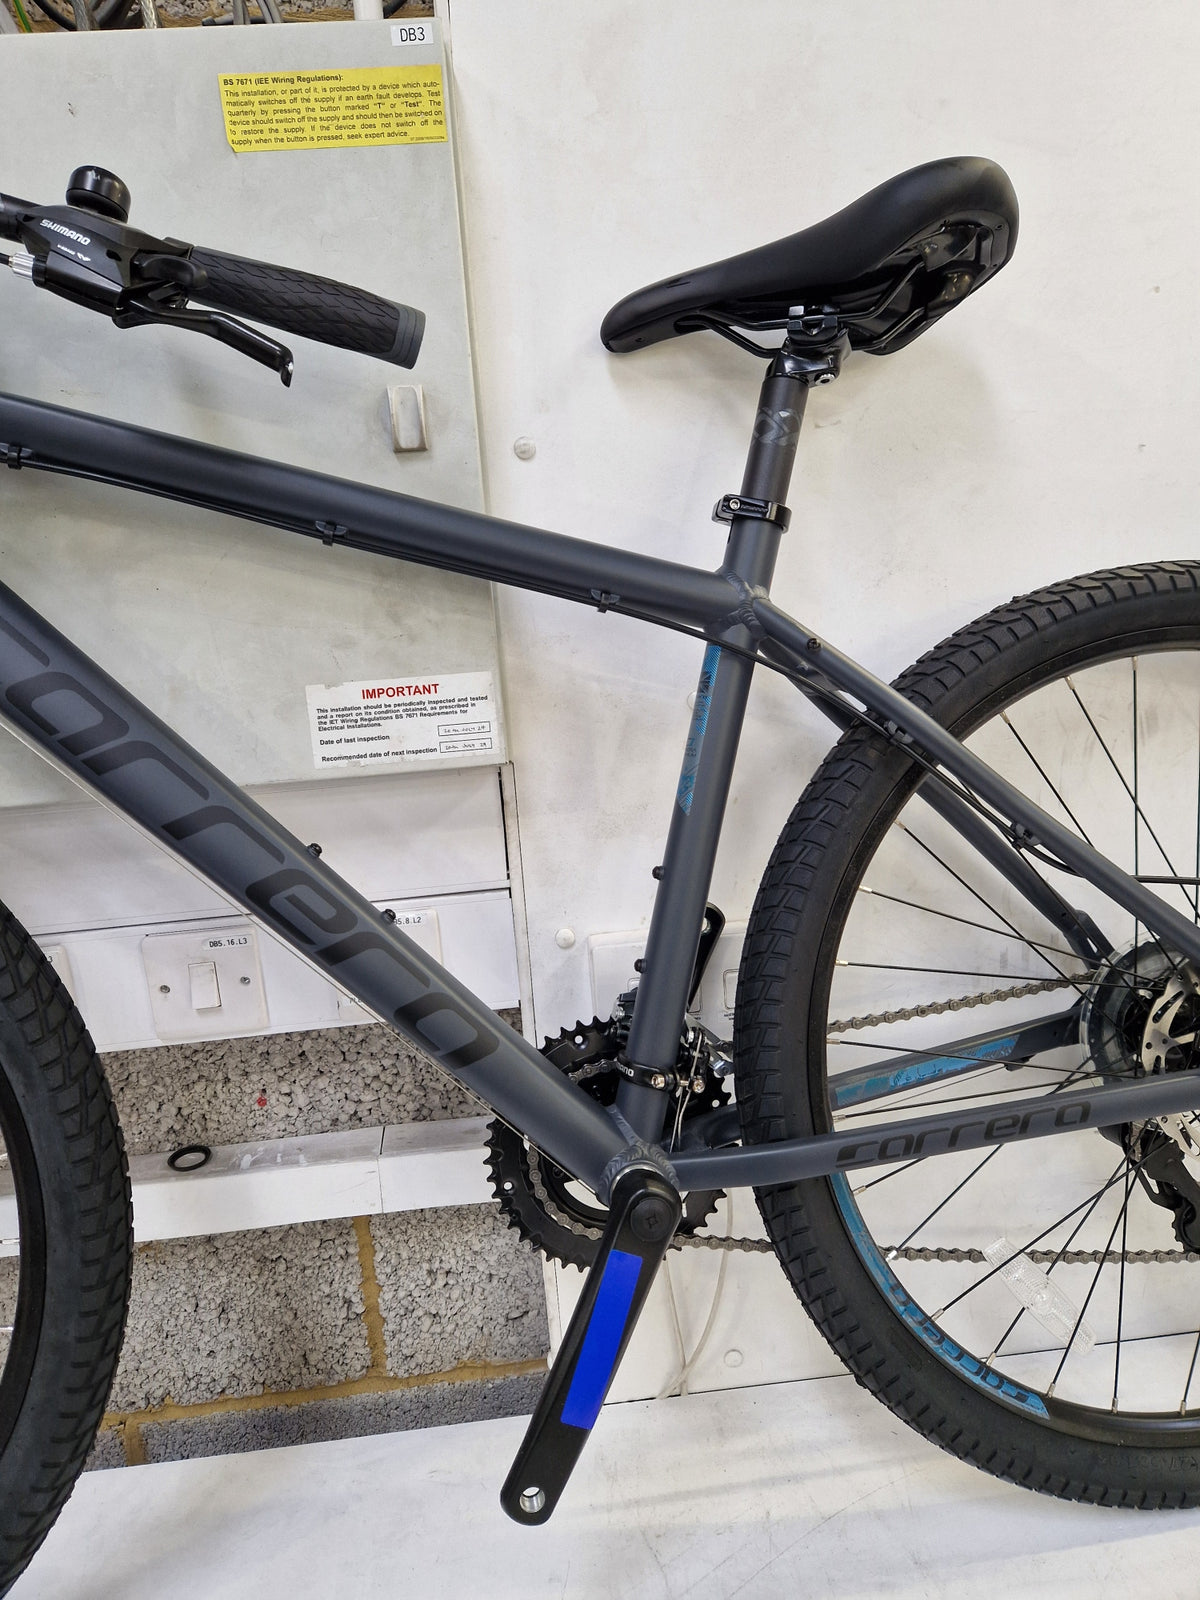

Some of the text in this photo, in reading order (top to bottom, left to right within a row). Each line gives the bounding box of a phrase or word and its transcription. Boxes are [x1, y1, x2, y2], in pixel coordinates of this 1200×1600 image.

[400, 26, 425, 42] DB3
[255, 78, 269, 86] (IEE
[271, 76, 294, 85] Wiring
[297, 74, 343, 84] Regulations):
[242, 88, 278, 96] installation,
[40, 219, 91, 246] SHIMANO
[362, 683, 439, 699] IMPORTANT
[322, 753, 367, 761] Recommended
[209, 937, 248, 947] DB5.16.L3
[836, 1101, 1092, 1168] carrera
